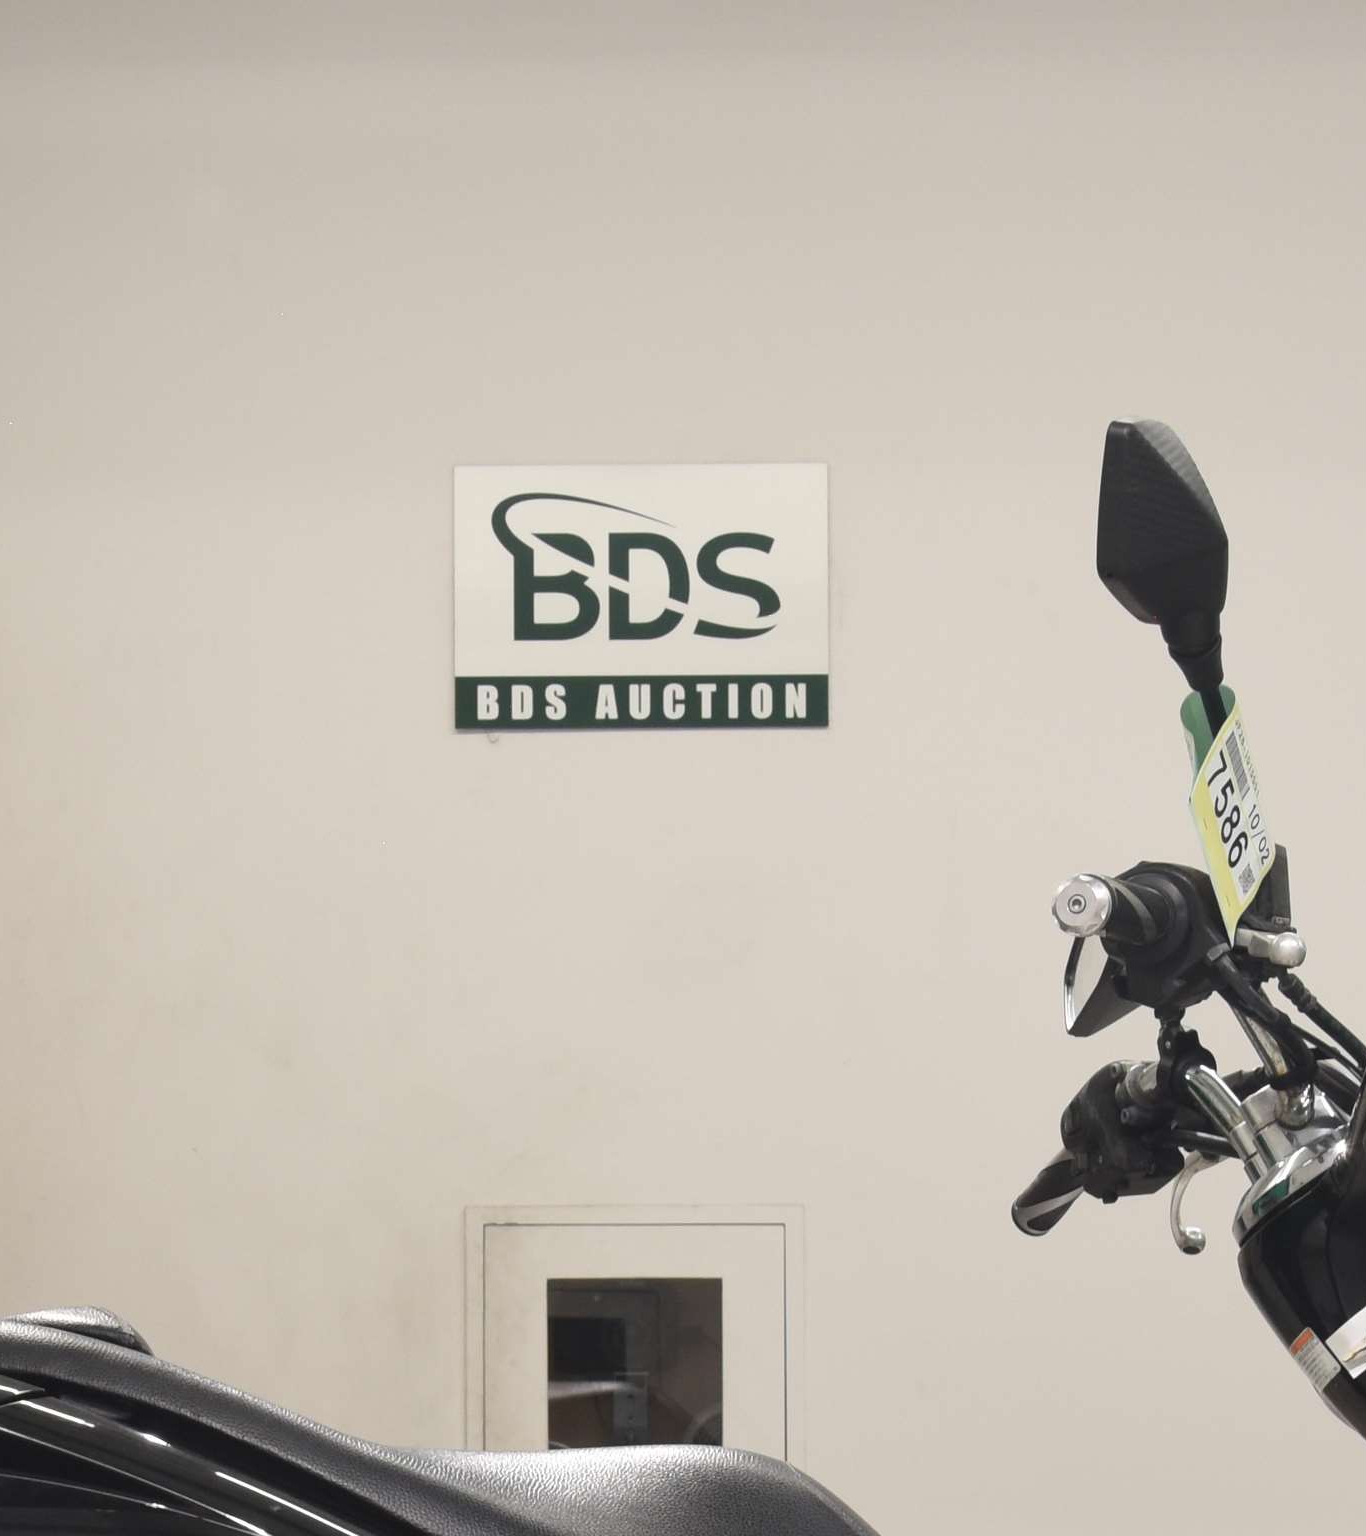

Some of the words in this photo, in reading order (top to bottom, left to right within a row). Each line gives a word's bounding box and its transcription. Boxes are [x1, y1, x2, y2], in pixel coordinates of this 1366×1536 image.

[492, 493, 781, 640] BDS
[476, 683, 567, 721] BDS
[595, 682, 807, 720] AUCTION
[1206, 750, 1249, 868] 7586
[1247, 803, 1271, 866] 10/02
